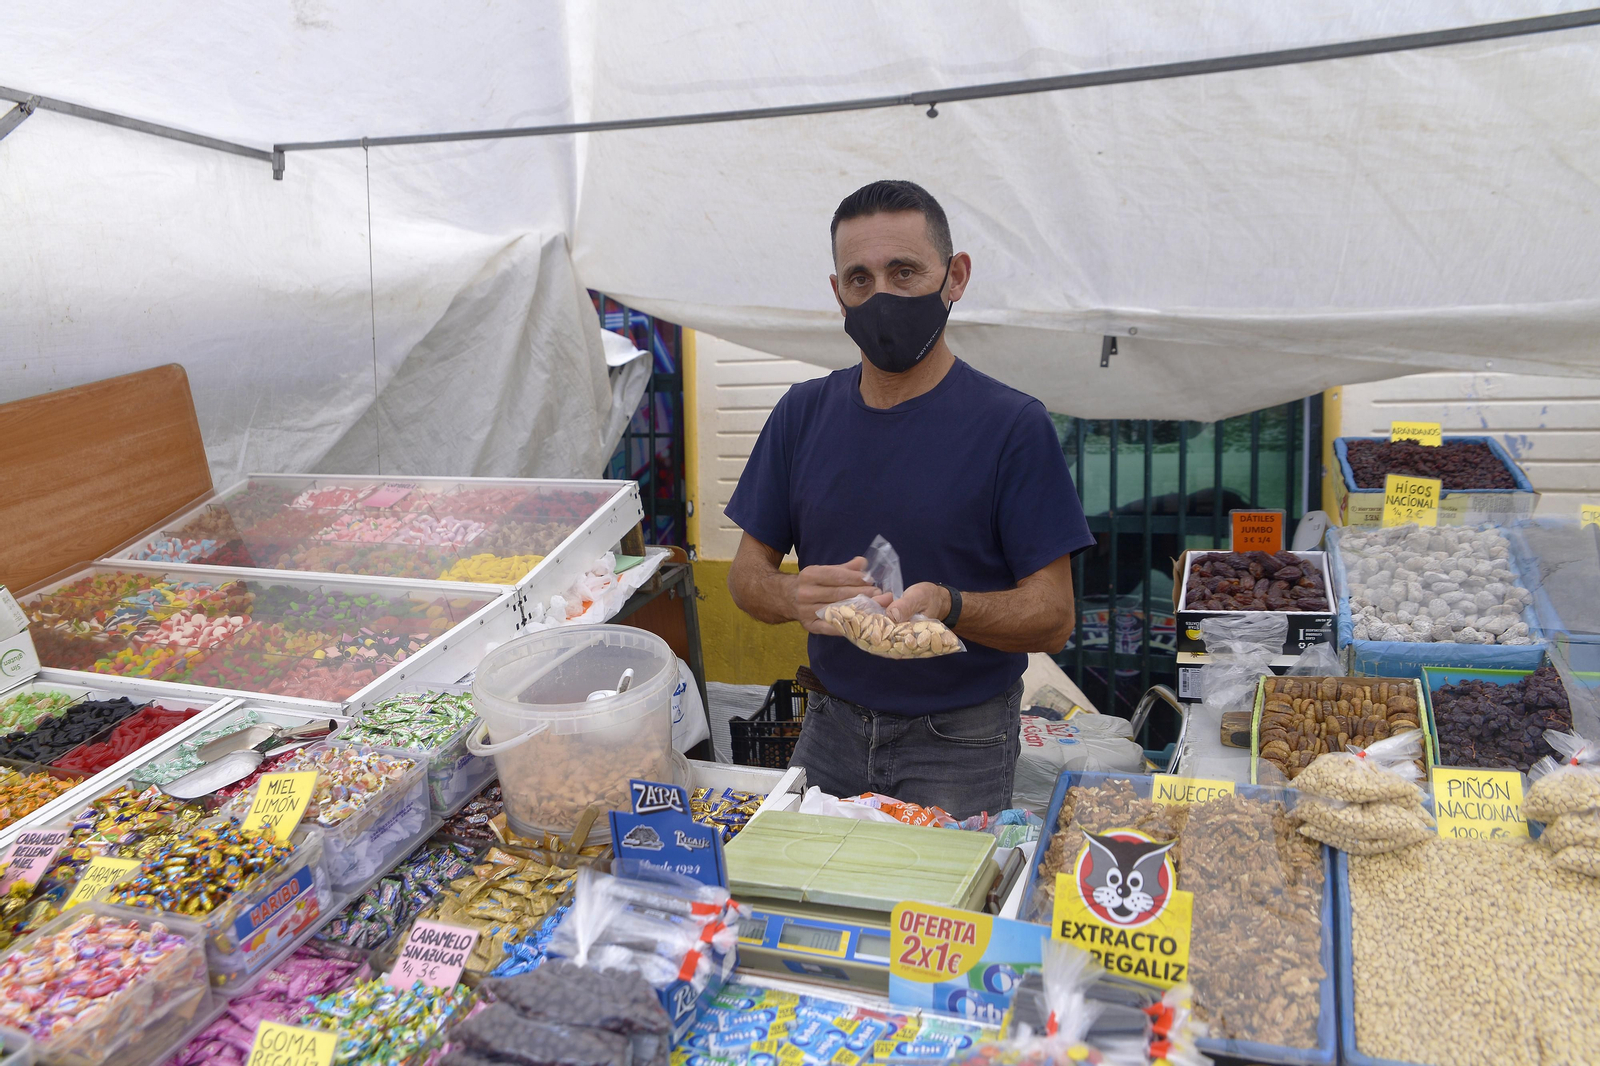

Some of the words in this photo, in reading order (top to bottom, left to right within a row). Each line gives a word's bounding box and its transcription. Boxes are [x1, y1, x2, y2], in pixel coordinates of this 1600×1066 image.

[1385, 494, 1437, 509] NACIONAL
[1240, 514, 1275, 523] DÁTILES
[1241, 526, 1273, 534] JUMBO
[3, 652, 24, 667] gluten
[10, 663, 22, 672] Sin
[266, 779, 296, 796] MIEL
[1446, 777, 1511, 801] PIÑÓN
[253, 795, 300, 814] LIMÓN
[633, 783, 684, 813] ZARA
[1438, 800, 1527, 823] NACIONAL
[15, 832, 66, 846] CARAMELO
[12, 846, 54, 858] RELLENO
[9, 858, 35, 869] MIEL
[83, 866, 127, 884] CARAMEL
[250, 878, 299, 927] HARIBO
[899, 909, 977, 946] OFERTA
[410, 926, 473, 951] CARAMELO
[1060, 919, 1178, 956] EXTRACTO
[898, 934, 963, 975] 2x1€
[947, 988, 1006, 1022] Orb
[260, 1028, 317, 1057] GOMA
[252, 1049, 319, 1066] REGA
